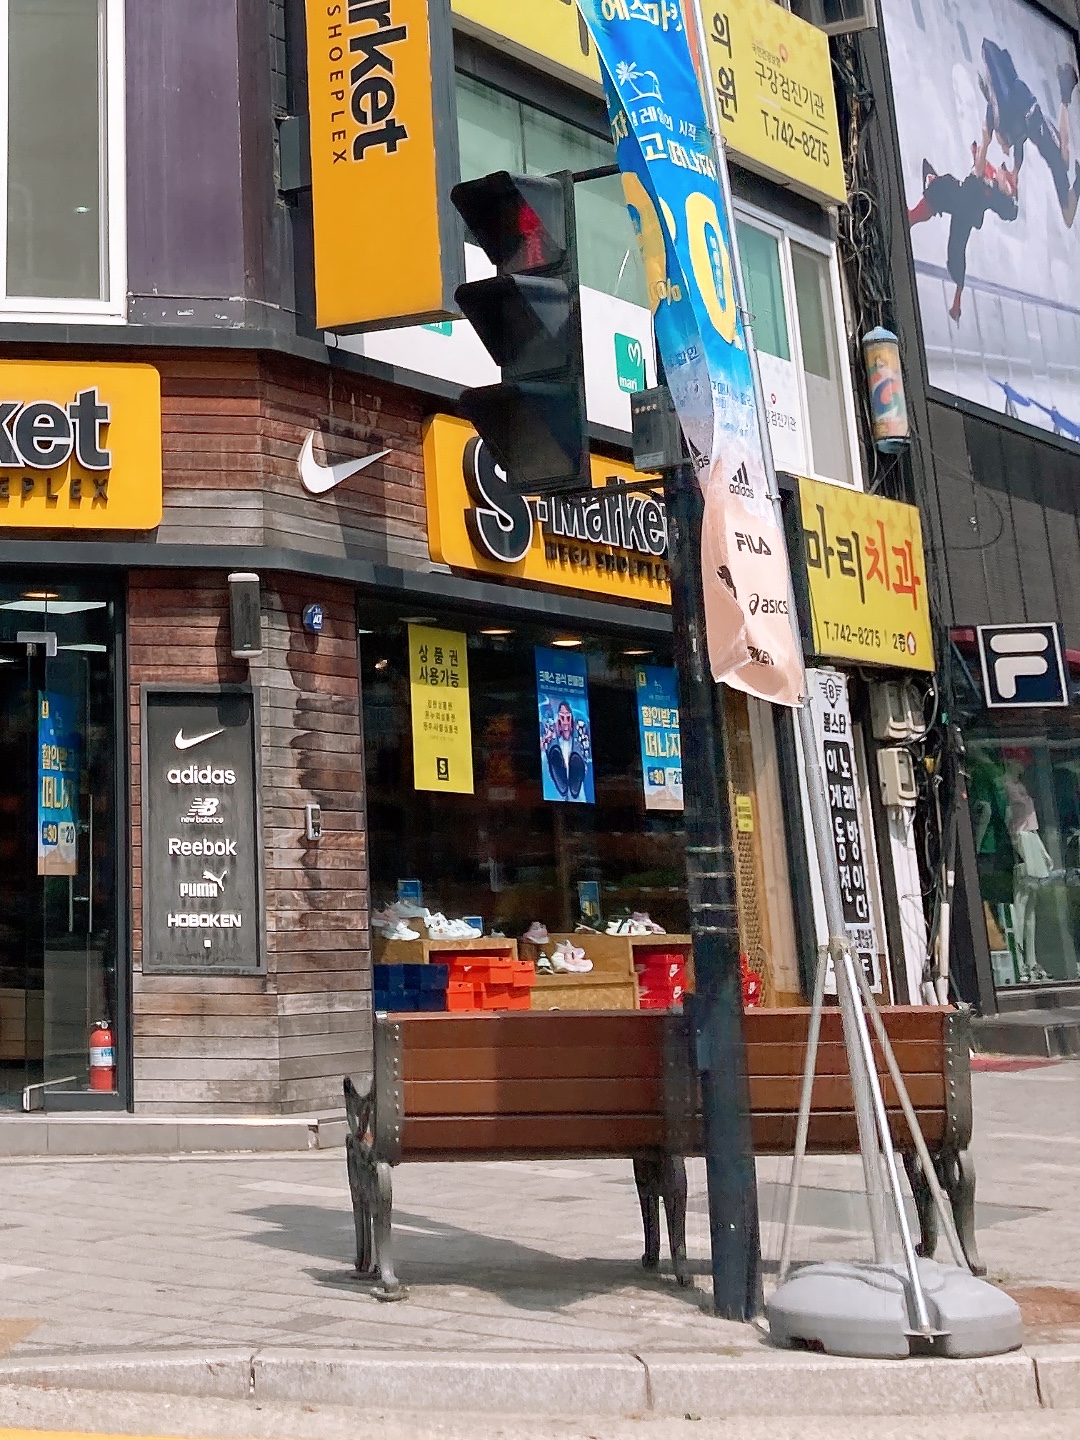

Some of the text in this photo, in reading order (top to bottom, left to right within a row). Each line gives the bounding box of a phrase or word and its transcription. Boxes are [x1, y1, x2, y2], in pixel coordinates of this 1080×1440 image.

[328, 5, 347, 164] SHOEPLEX
[755, 60, 825, 120] 구강검진기관
[761, 110, 829, 166] T.742-8275
[729, 483, 754, 498] adidas
[735, 531, 772, 555] FILA
[803, 504, 920, 611] 마리치과
[824, 620, 881, 648] T.742-8275
[420, 665, 459, 688] 사용가능
[167, 765, 236, 785] adidas
[168, 837, 237, 857] Reebok
[180, 882, 218, 898] PUMA
[167, 913, 242, 928] HOBOKEN
